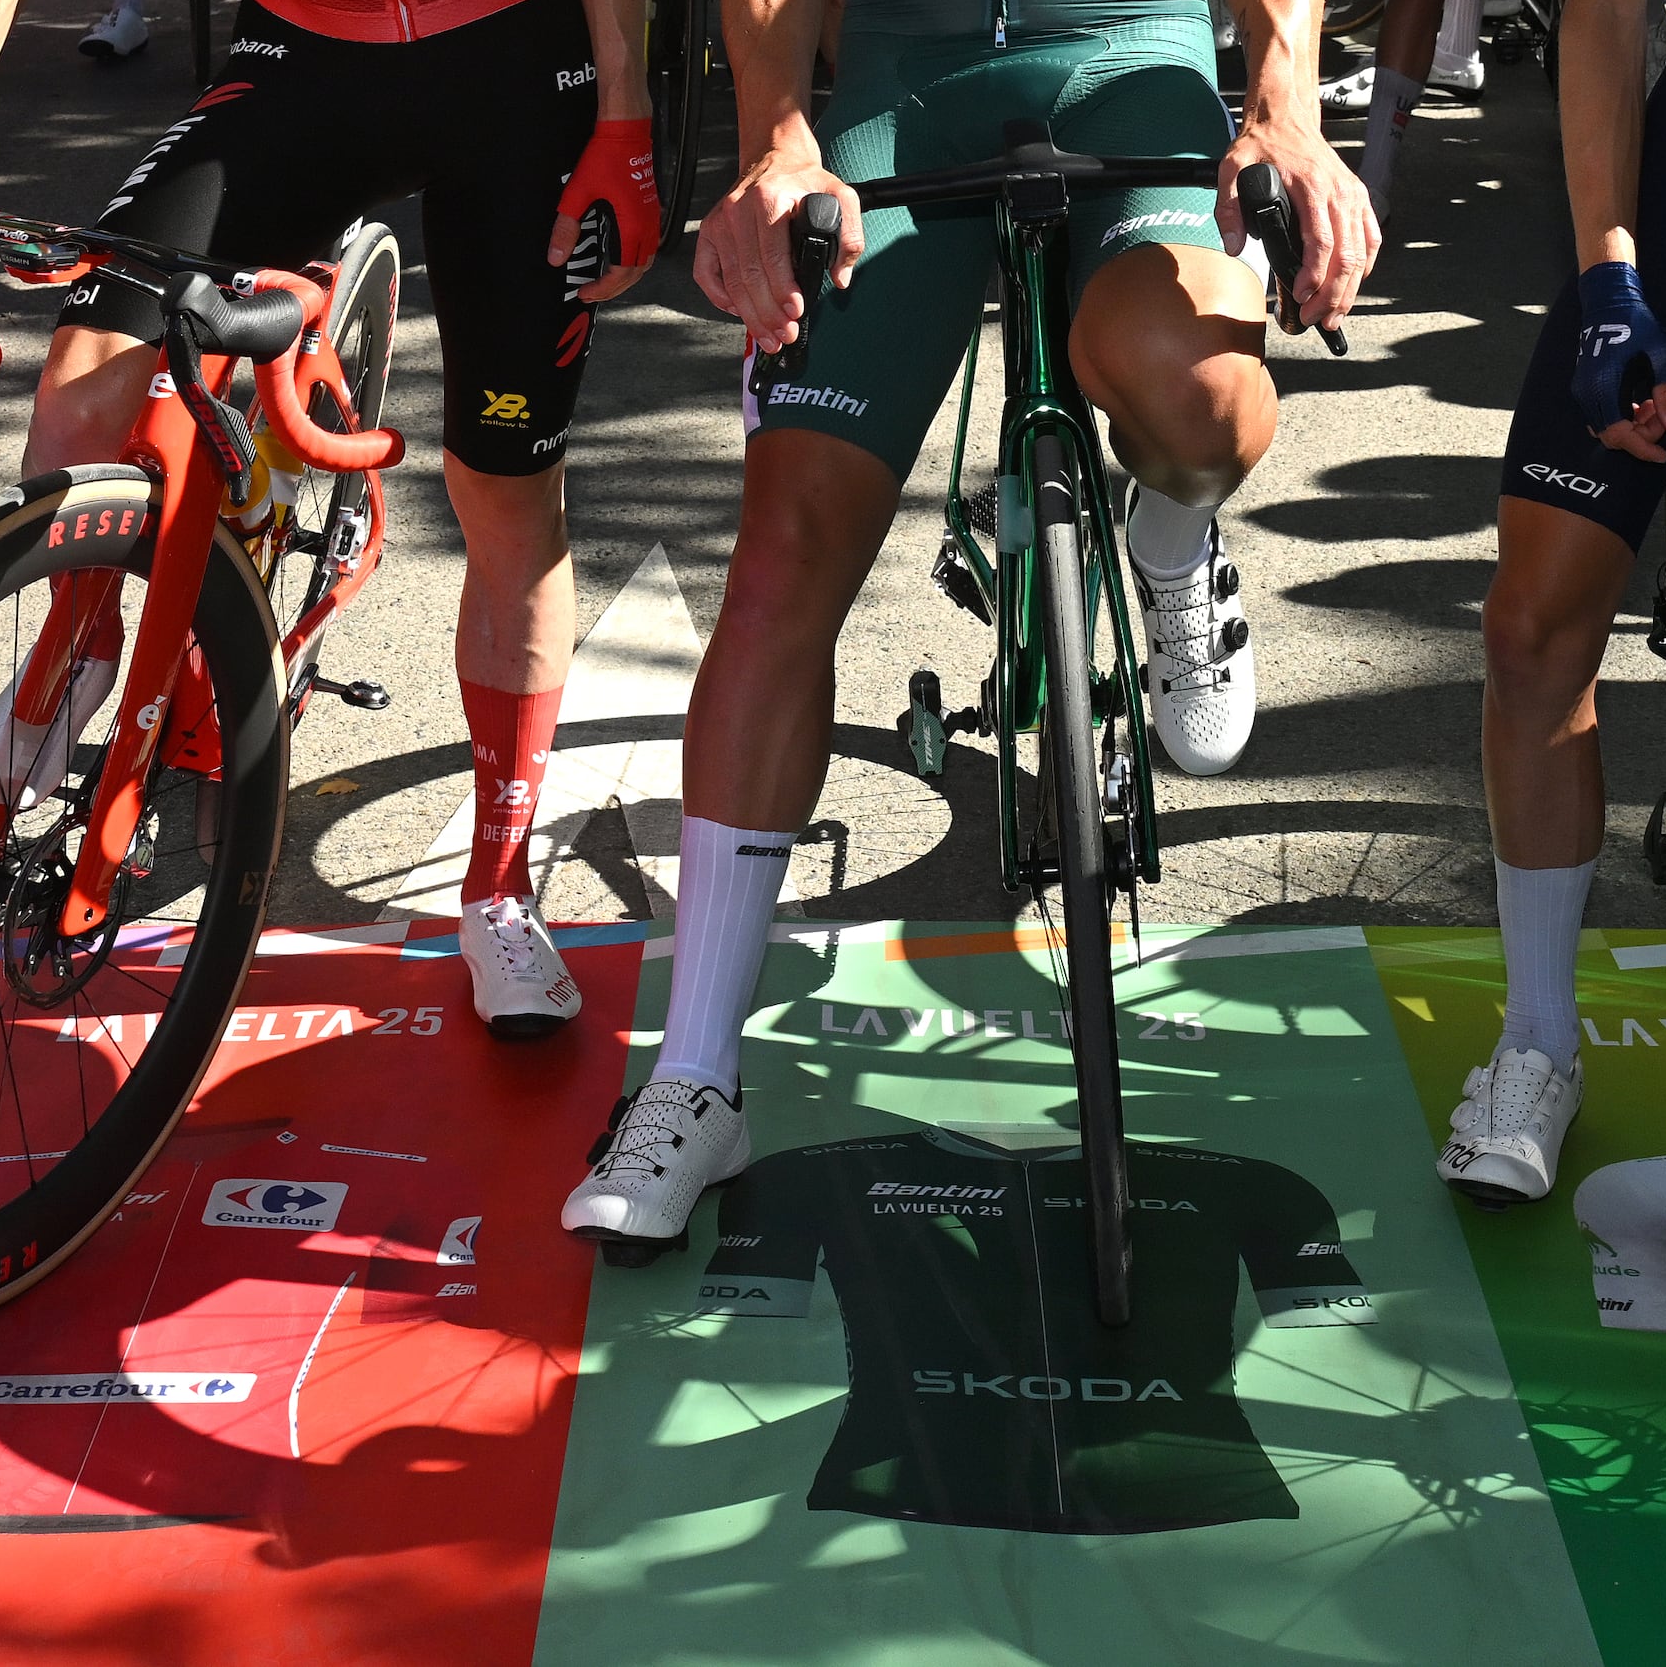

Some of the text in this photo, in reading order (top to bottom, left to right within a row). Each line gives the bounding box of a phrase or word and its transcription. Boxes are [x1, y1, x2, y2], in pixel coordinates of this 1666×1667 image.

[1100, 207, 1215, 249] Santini
[767, 382, 869, 419] Santini
[480, 418, 514, 428] yellow
[57, 1014, 123, 1043] LA
[370, 1005, 445, 1036] 25
[821, 1004, 888, 1036] LA
[1137, 1012, 1207, 1041] 25
[1582, 1018, 1656, 1047] LA
[866, 1181, 1008, 1200] Santini
[215, 1211, 326, 1228] Carrefour
[873, 1201, 1004, 1217] LA VUELTA 25
